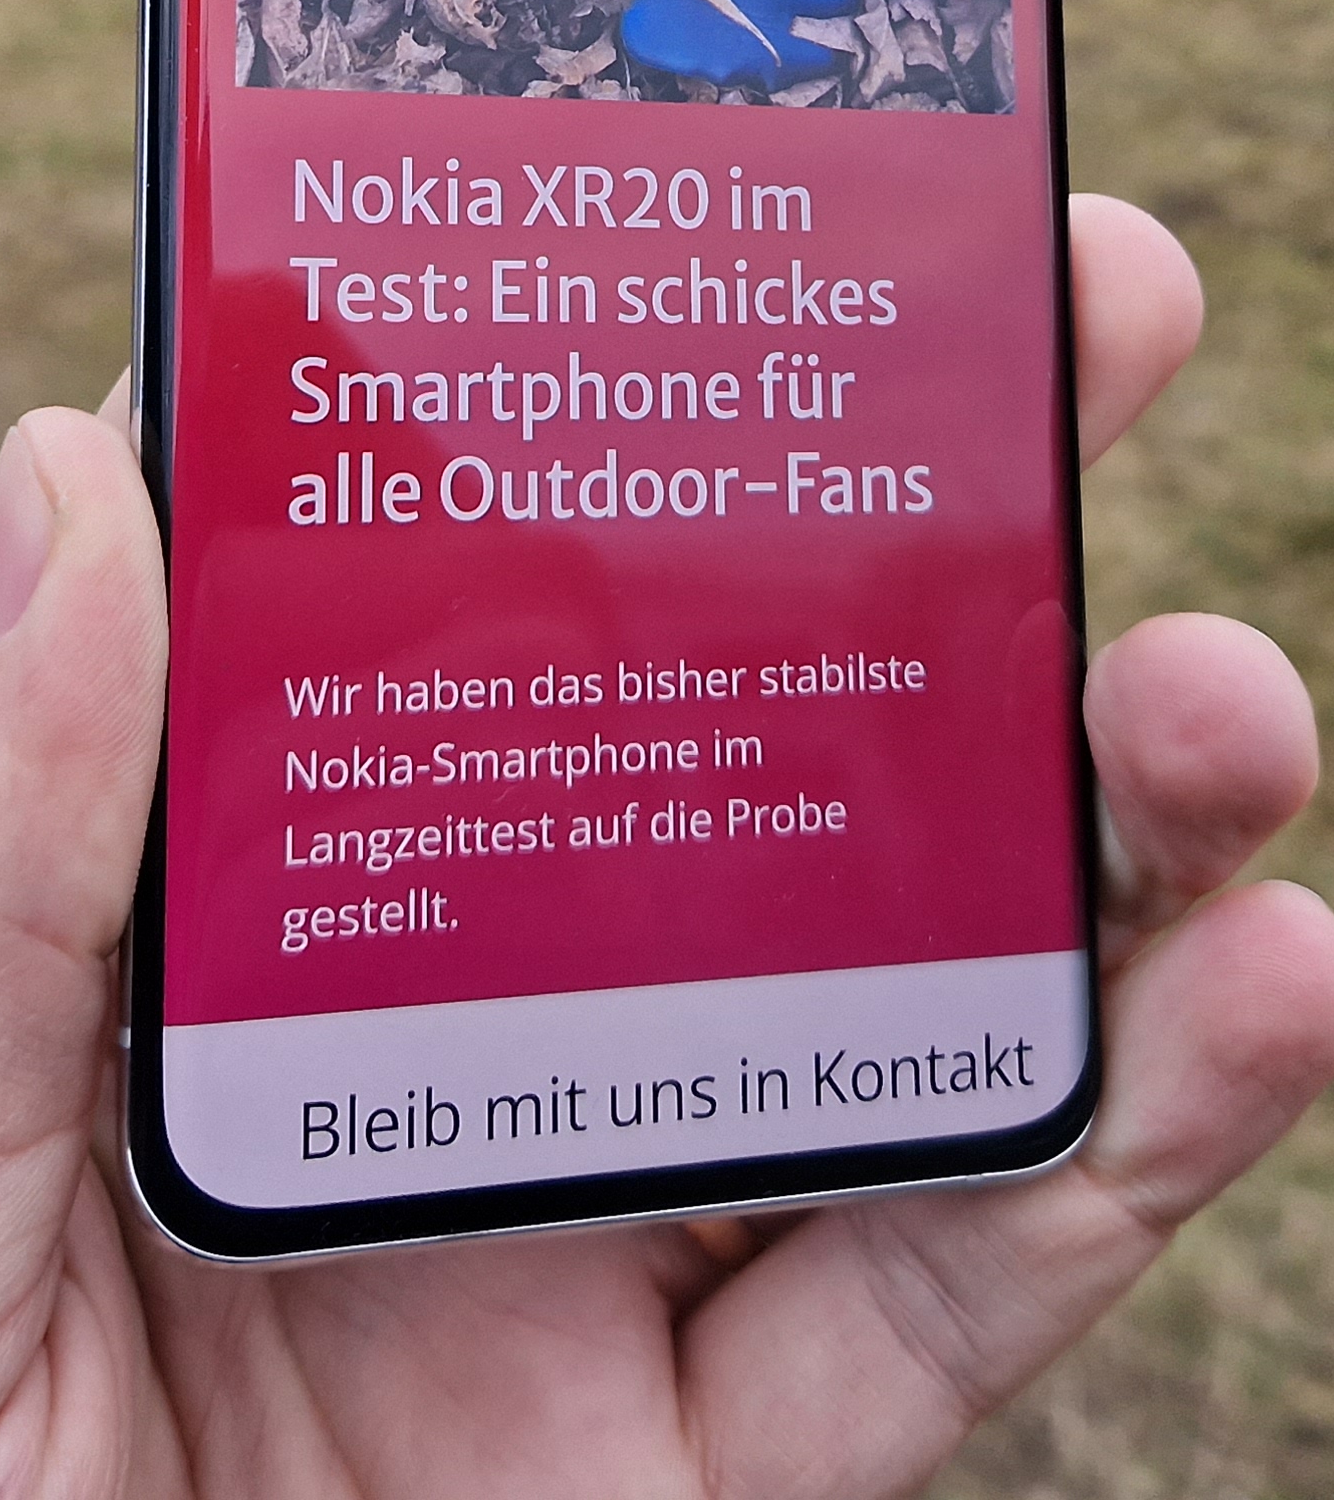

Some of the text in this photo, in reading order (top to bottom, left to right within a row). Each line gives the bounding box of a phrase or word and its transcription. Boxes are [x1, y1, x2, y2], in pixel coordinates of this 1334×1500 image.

[293, 156, 812, 232] Nokia XR20 im
[288, 255, 898, 327] Test: Ein schickes
[290, 352, 856, 442] Smartphone für
[287, 451, 422, 526] alle
[284, 651, 927, 720] Wir haben das bisher stabilste
[284, 727, 763, 795] Nokia-Smartphone im
[283, 791, 848, 876] Langzeittest auf die Probe
[279, 886, 459, 957] gestellt.
[302, 1031, 1035, 1162] Bleib mit uns in Kontakt
